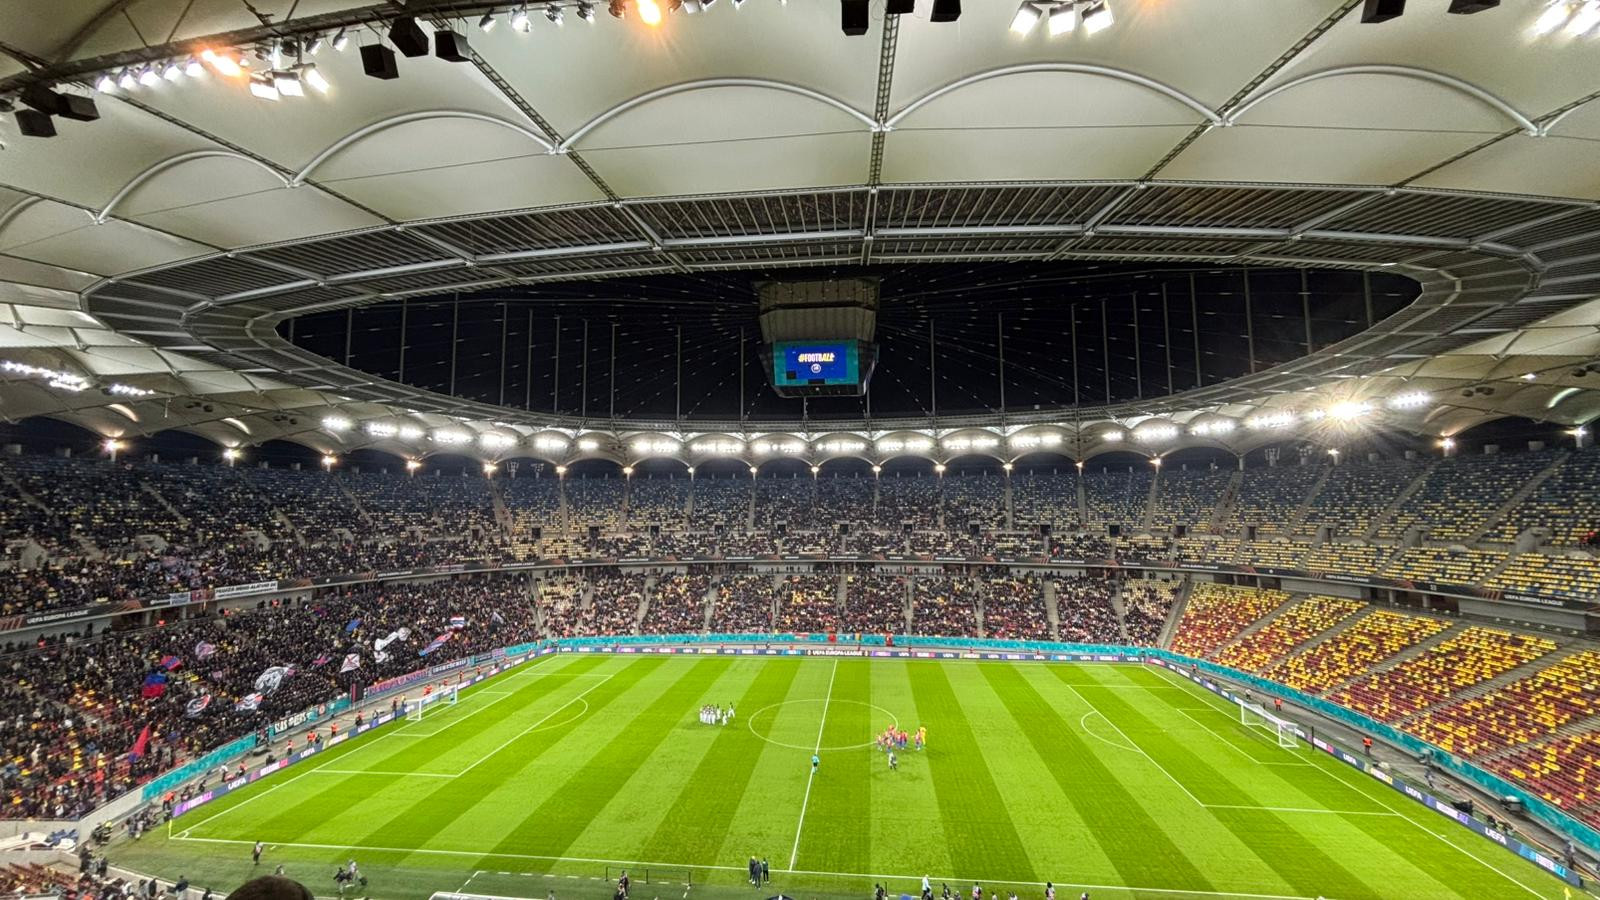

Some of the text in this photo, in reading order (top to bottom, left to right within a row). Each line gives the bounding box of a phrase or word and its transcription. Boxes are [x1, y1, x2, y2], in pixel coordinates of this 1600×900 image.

[227, 777, 247, 790] UEFA
[1405, 785, 1423, 800] UEFA
[1484, 826, 1507, 845] UEFA
